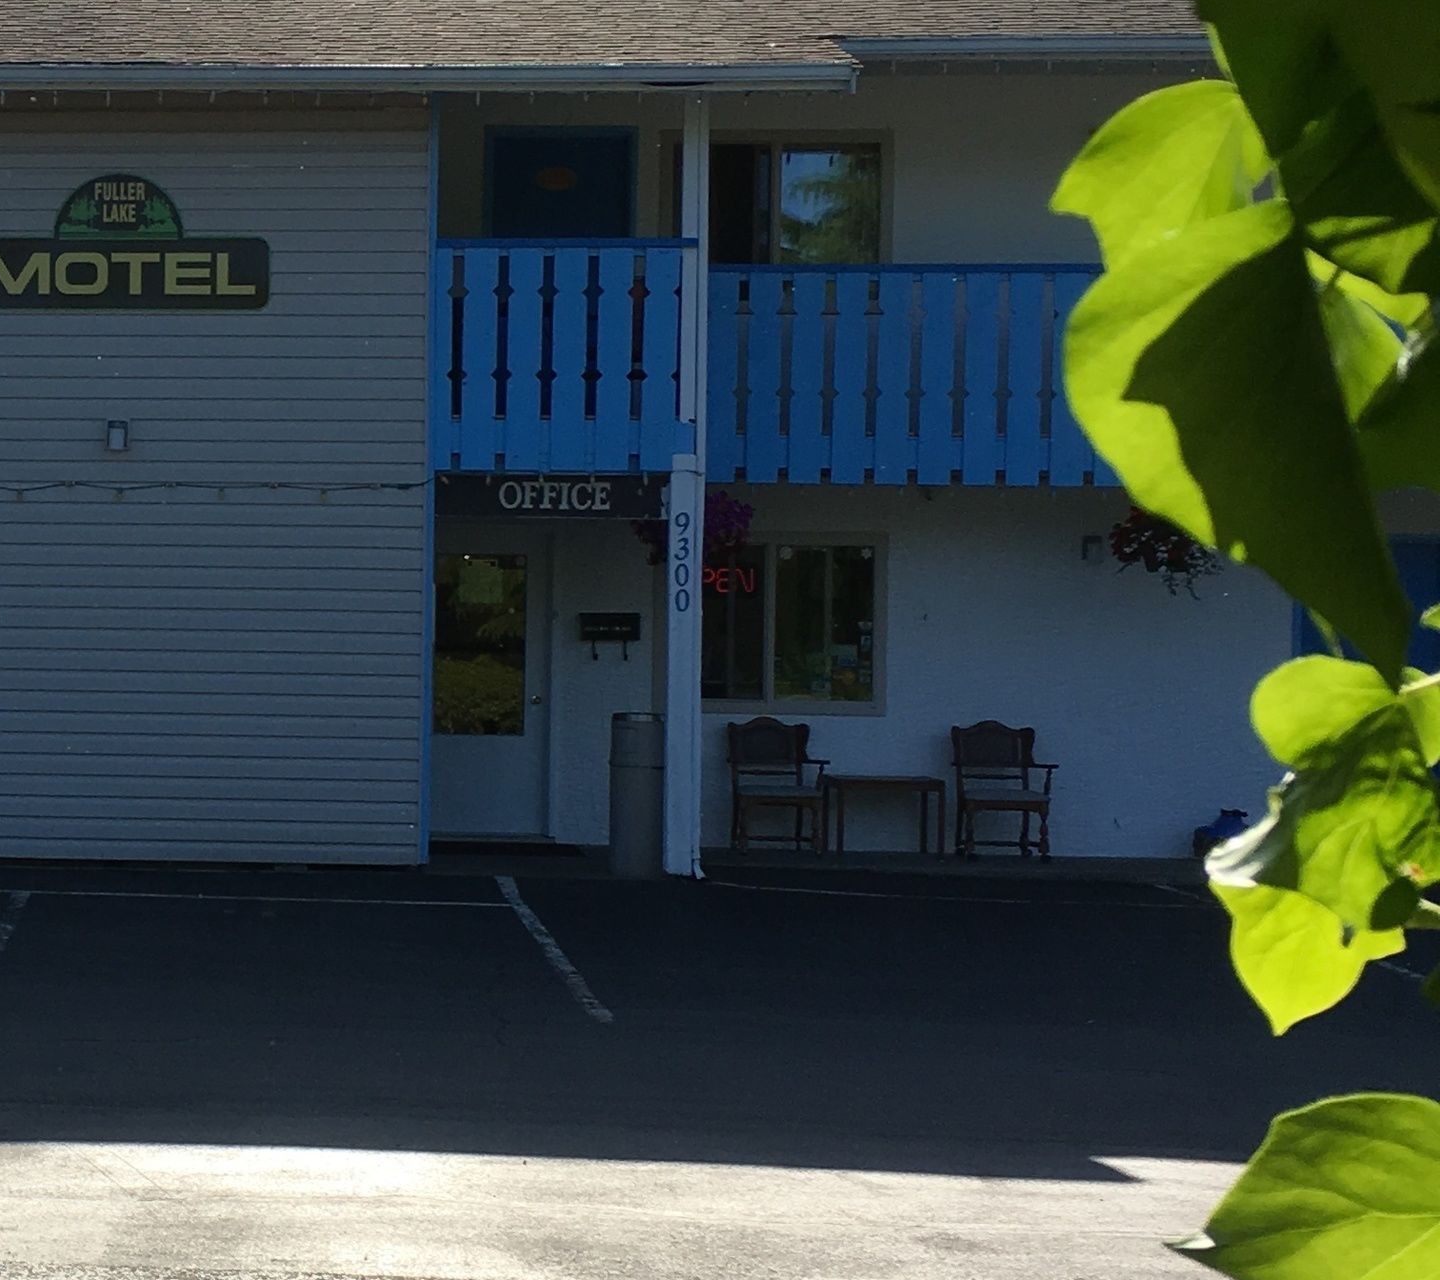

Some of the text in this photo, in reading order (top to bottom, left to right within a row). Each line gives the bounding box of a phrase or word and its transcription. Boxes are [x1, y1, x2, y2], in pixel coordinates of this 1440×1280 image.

[94, 182, 145, 201] FULLER
[103, 204, 136, 223] LAKE
[499, 481, 610, 510] OFFICE
[674, 512, 690, 612] 9300
[702, 568, 754, 593] PEN
